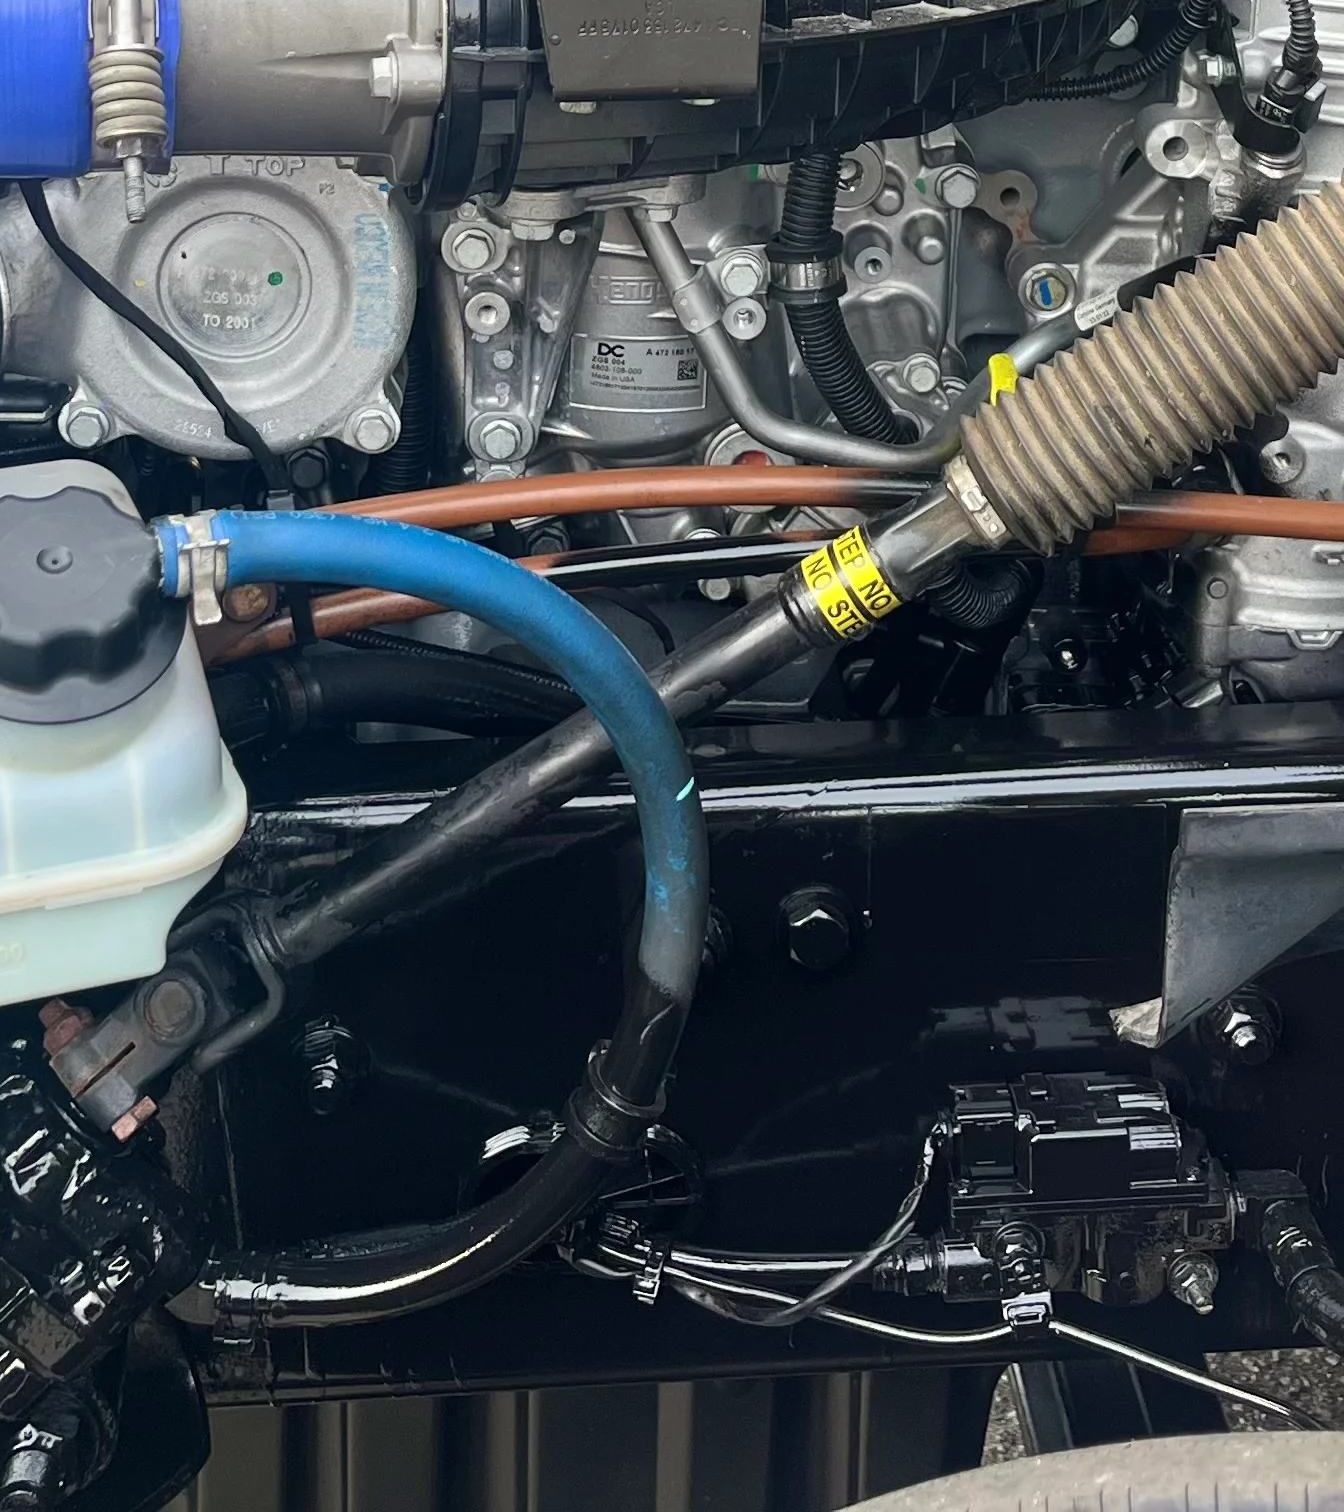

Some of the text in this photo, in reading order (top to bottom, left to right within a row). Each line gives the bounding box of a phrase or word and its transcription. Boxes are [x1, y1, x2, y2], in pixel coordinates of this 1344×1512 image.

[245, 155, 306, 177] TOP
[203, 291, 230, 304] ZGS
[597, 342, 626, 358] DC
[591, 372, 610, 381] Made
[837, 532, 893, 612] TEP NO
[805, 556, 865, 636] NO STE
